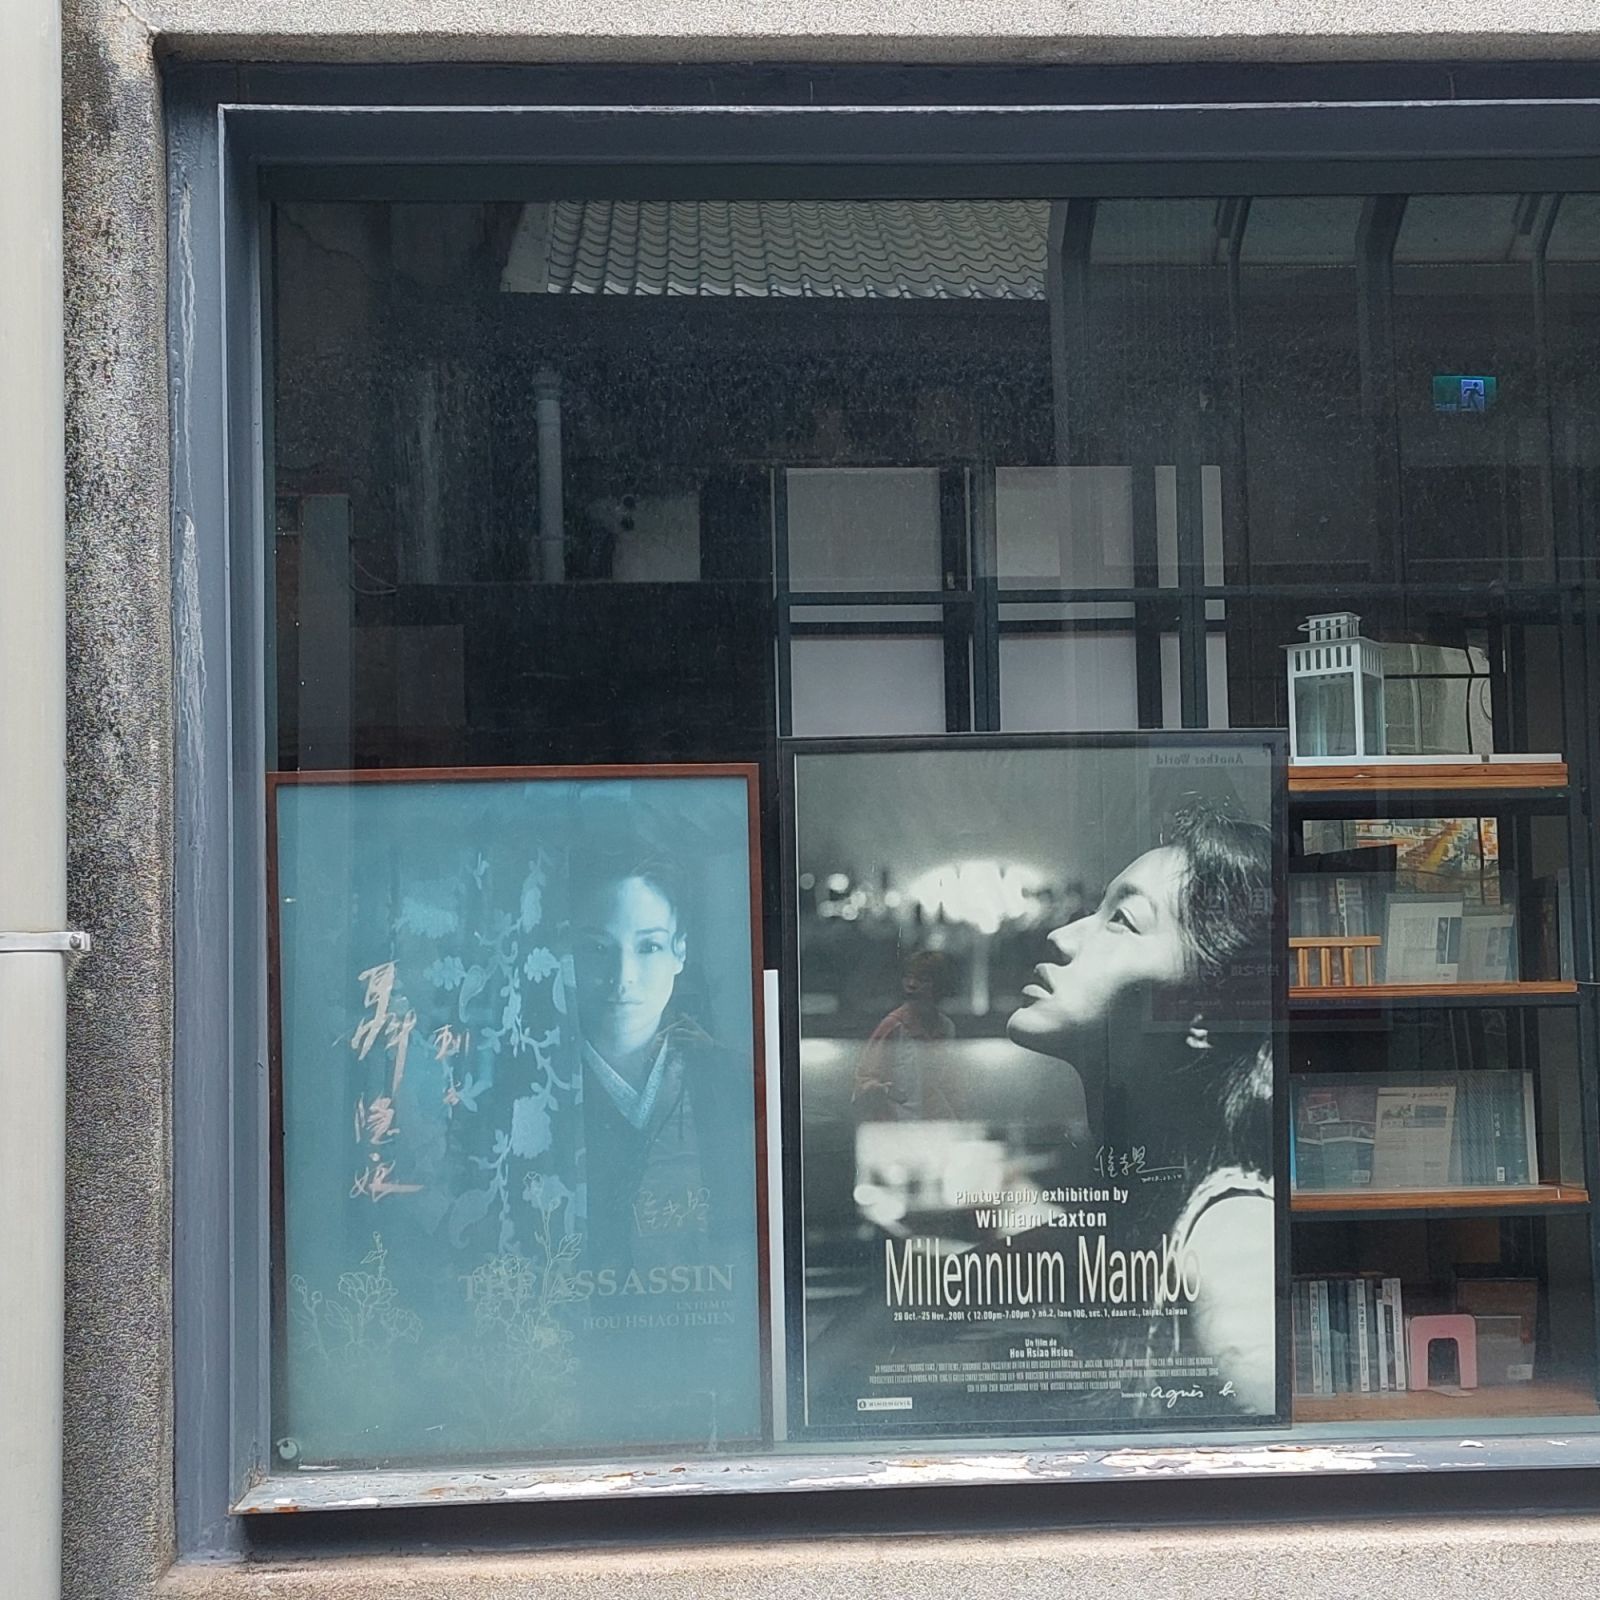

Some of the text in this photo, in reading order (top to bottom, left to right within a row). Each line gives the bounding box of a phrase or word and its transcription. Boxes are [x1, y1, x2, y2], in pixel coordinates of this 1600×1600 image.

[954, 1187, 1129, 1205] Photography exhibition by
[975, 1209, 1107, 1228] William Laxton
[550, 1264, 735, 1298] ASSASSIN
[885, 1234, 1201, 1307] Millennium Mambo
